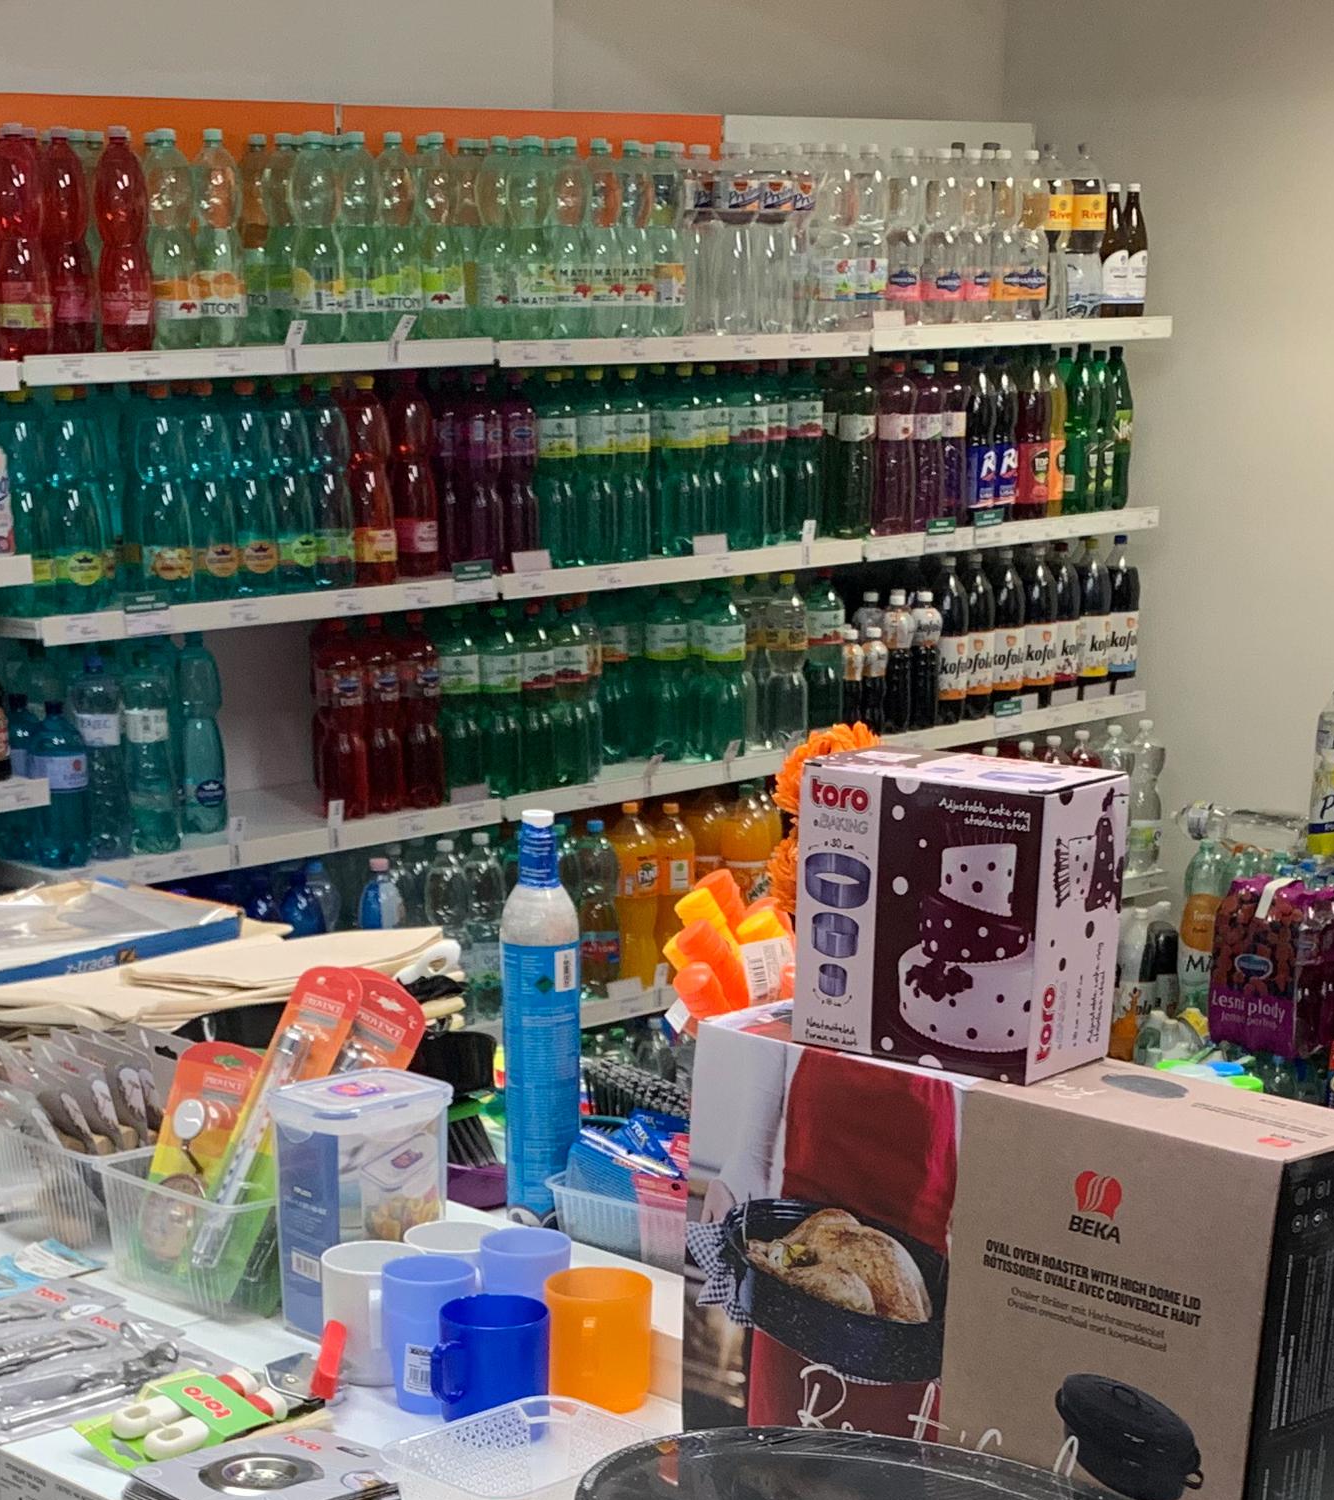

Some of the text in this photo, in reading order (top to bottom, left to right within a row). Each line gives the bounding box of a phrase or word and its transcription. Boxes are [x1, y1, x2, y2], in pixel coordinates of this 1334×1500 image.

[810, 778, 871, 814] toro
[939, 798, 1031, 822] Adjustable cake ring
[817, 816, 869, 835] BAKING
[964, 815, 1031, 832] stainless steel
[304, 993, 345, 1014] PROVENCE
[1248, 999, 1286, 1022] plody
[356, 1009, 403, 1038] PROVENCE
[1035, 985, 1055, 1062] toro
[204, 1075, 245, 1090] PROVENCE
[1069, 1215, 1121, 1244] BEKA
[985, 1239, 1201, 1310] OVAL OVEN ROASTER WITH HIGH DOME LID
[1043, 1270, 1076, 1292] OVALE
[1077, 1280, 1105, 1300] AVEC
[1106, 1287, 1168, 1319] COUVERCLE
[1170, 1306, 1201, 1327] HAUT
[183, 1386, 233, 1419] toro
